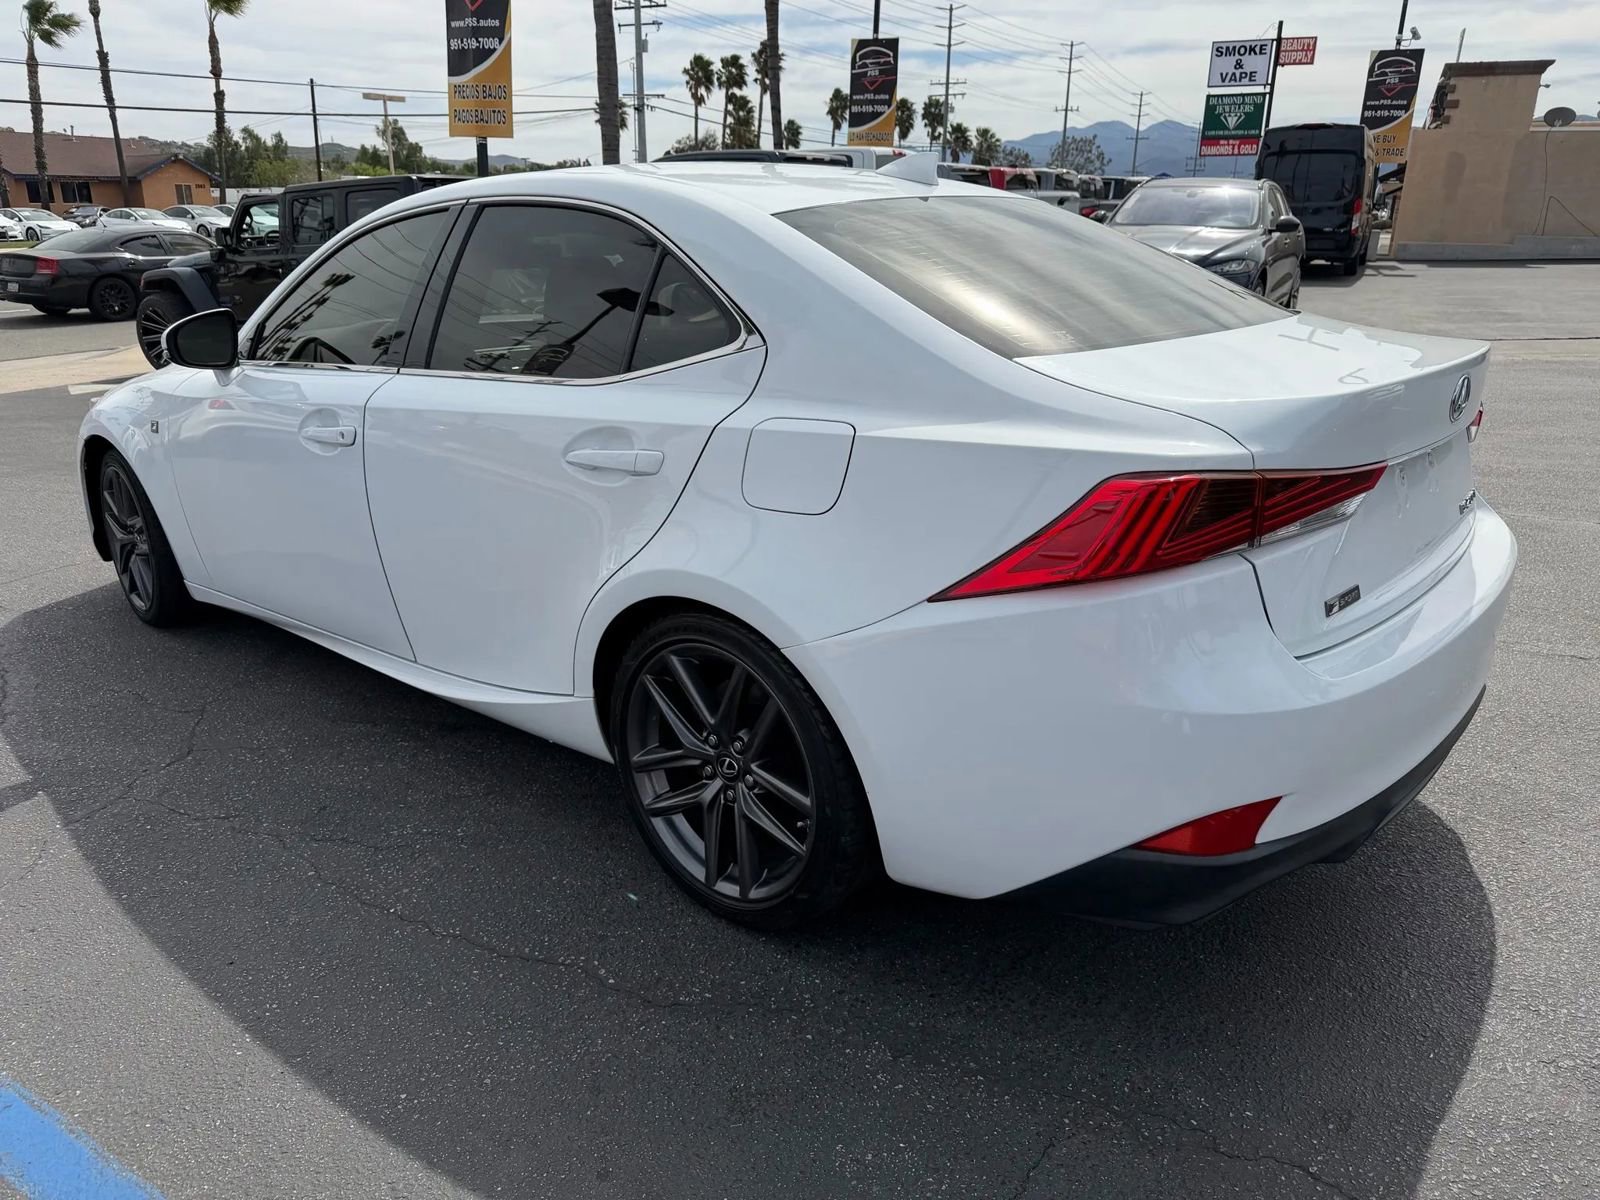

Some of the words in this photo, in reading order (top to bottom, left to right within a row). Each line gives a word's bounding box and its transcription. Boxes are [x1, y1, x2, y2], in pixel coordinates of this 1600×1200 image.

[450, 18, 500, 28] www.PSS.autos
[450, 38, 500, 50] 951-519-7008
[1281, 38, 1316, 50] BEAUTY
[1215, 44, 1268, 58] SMOKE
[1280, 51, 1313, 63] SUPPLY
[1234, 58, 1244, 70] &
[1220, 71, 1258, 84] VAPE
[454, 84, 480, 100] PRECIOS
[482, 85, 508, 100] BAJOS
[1210, 96, 1243, 105] DIAMOND
[1244, 95, 1263, 104] MIND
[1214, 104, 1254, 114] JEWELERS
[454, 109, 474, 124] PAGOS
[474, 109, 506, 124] BAJITOS
[1382, 134, 1396, 143] BUY
[1201, 145, 1233, 155] DIAMONDS
[1234, 145, 1239, 154] &
[1240, 144, 1257, 154] GOLD
[1382, 148, 1404, 156] TRADE
